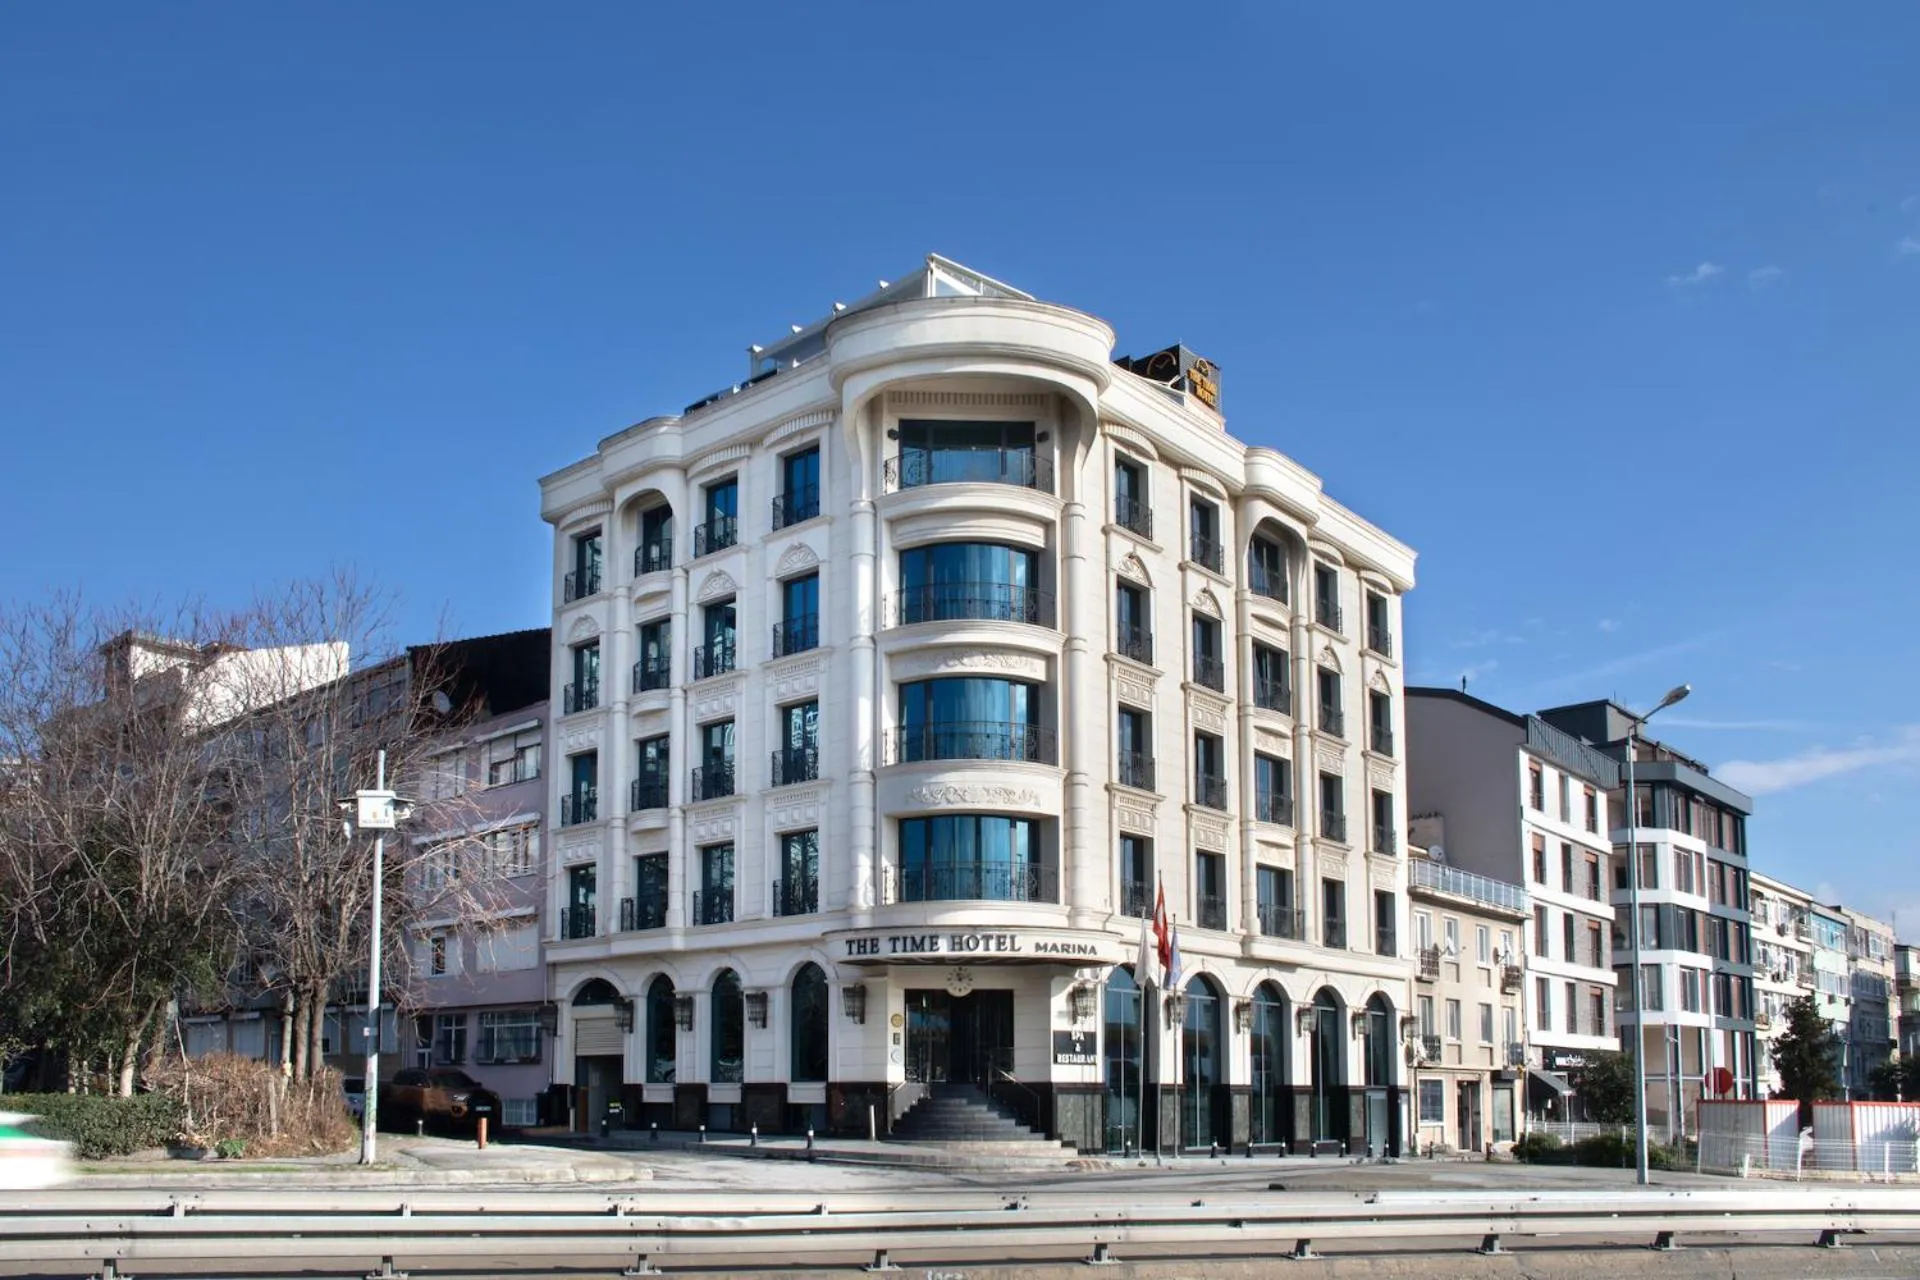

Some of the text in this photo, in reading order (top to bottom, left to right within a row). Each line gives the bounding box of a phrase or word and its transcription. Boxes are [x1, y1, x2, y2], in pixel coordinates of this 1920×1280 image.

[845, 934, 1098, 955] THE TIME HOTEL MARINA
